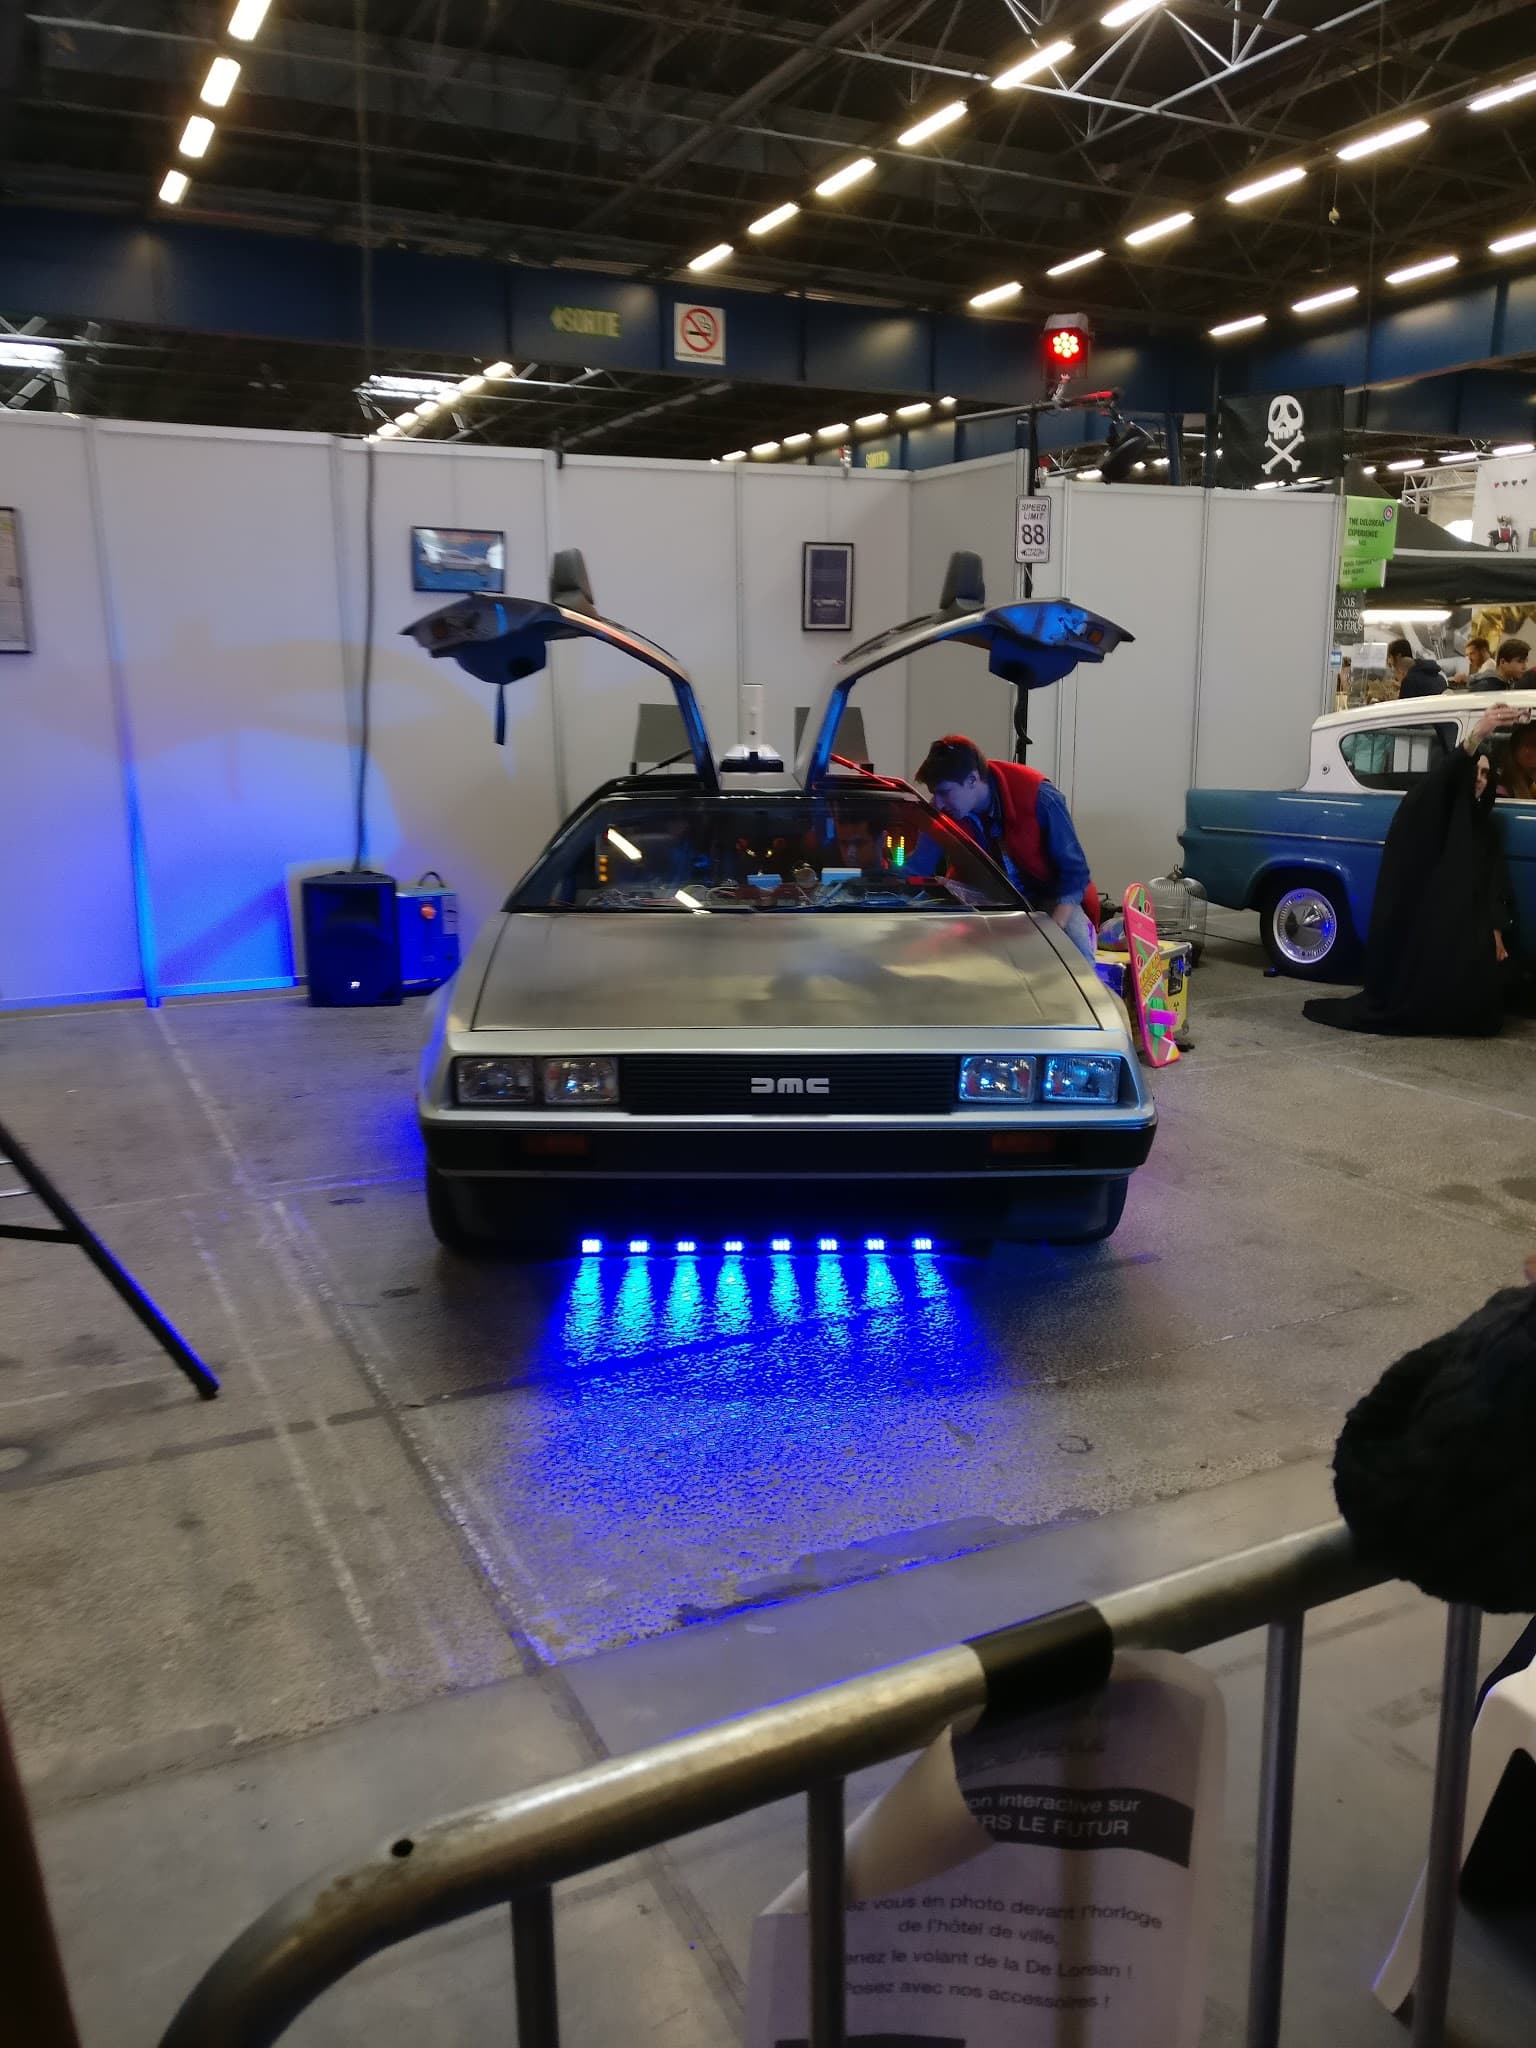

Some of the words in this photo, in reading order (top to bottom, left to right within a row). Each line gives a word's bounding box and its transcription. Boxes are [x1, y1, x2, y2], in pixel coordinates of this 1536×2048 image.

[1021, 503, 1047, 511] SPEED
[1022, 524, 1045, 545] 88
[751, 1077, 830, 1094] DMC
[999, 1793, 1102, 1814] interactive
[1108, 1799, 1141, 1813] sur
[1018, 1815, 1047, 1833] LE
[1053, 1819, 1129, 1838] FUTUR
[846, 1900, 866, 1912] ez
[873, 1896, 916, 1910] vous
[922, 1895, 945, 1908] en
[950, 1893, 1006, 1912] photo
[1010, 1901, 1075, 1921] devant
[1081, 1903, 1163, 1929] l'horloge
[898, 1919, 922, 1933] de
[927, 1918, 984, 1935] l'hôtel
[989, 1924, 1013, 1939] de
[845, 1952, 887, 1965] enez
[891, 1949, 908, 1963] le
[913, 1951, 969, 1965] volant
[974, 1953, 998, 1969] de
[1003, 1956, 1020, 1972] la
[1025, 1958, 1053, 1976] De
[1057, 1962, 1121, 1978] Lorean
[900, 1982, 943, 1995] avec
[949, 1984, 983, 1999] nos
